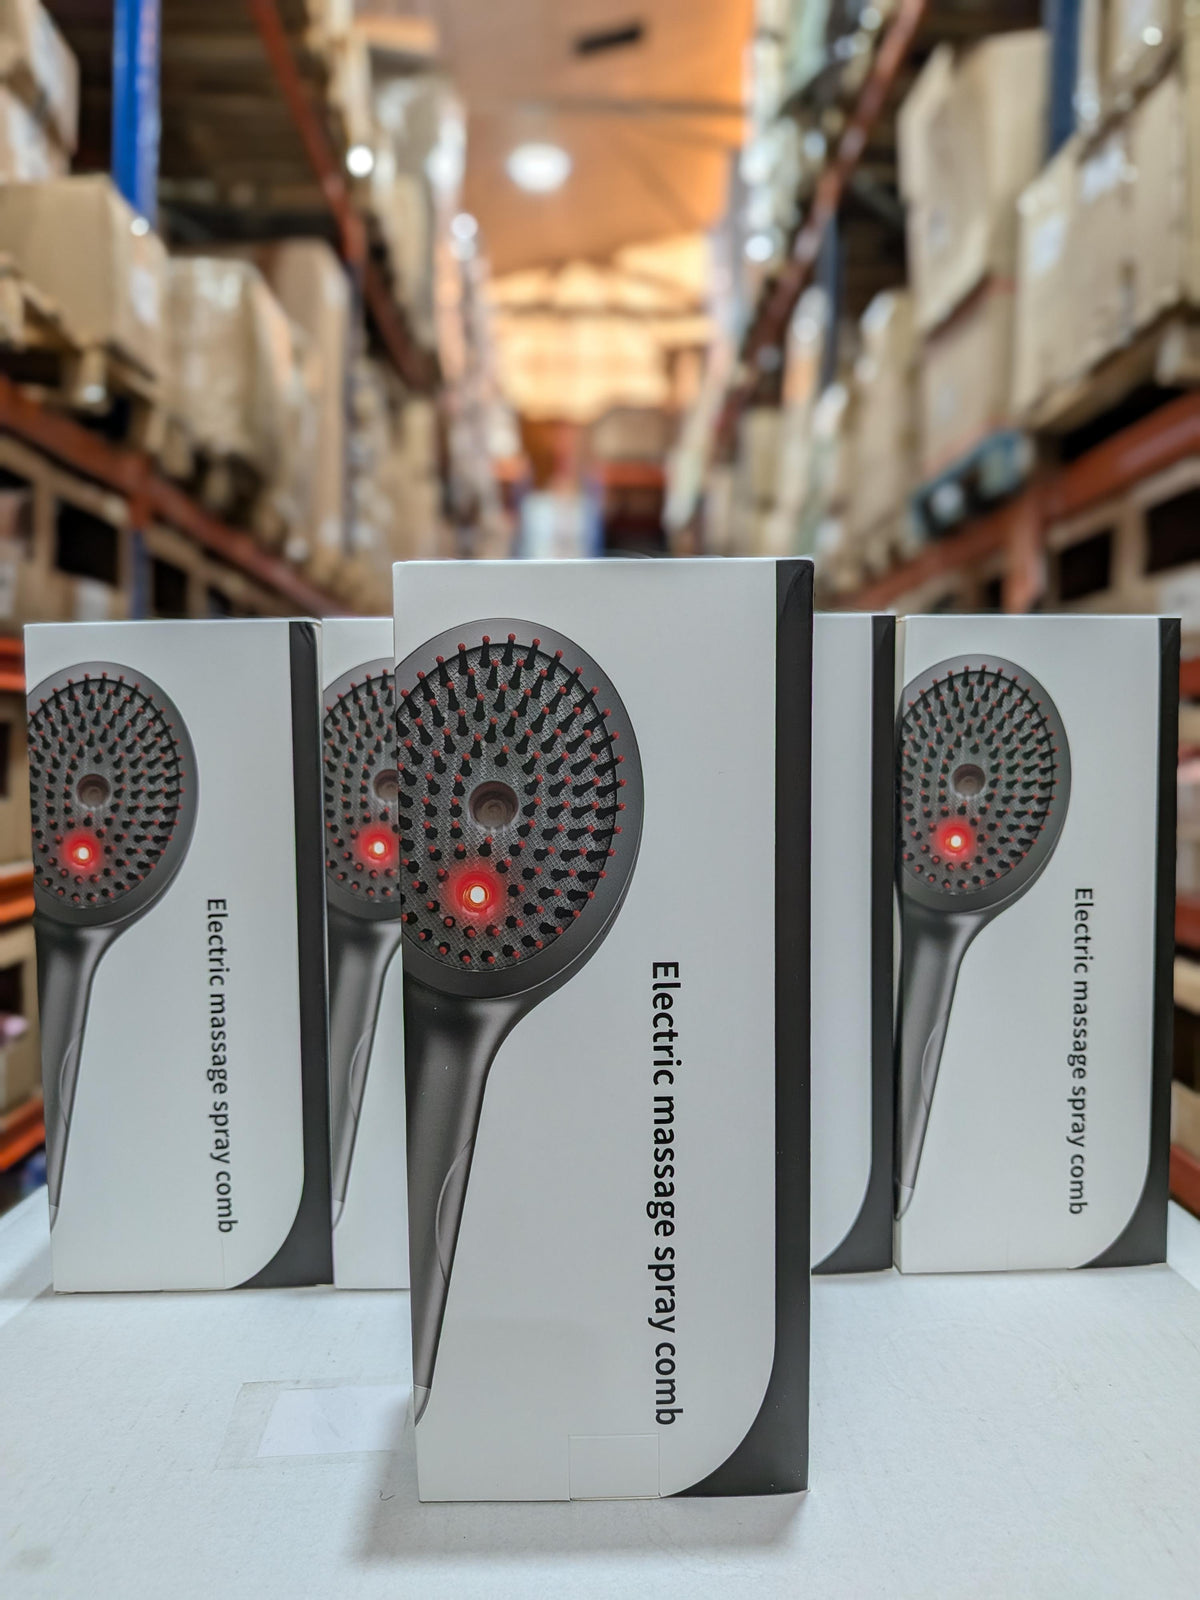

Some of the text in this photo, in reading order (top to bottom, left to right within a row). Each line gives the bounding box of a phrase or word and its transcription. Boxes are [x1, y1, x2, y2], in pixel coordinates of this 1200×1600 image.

[206, 898, 239, 1233] Electric massage spray comb
[645, 961, 684, 1426] Electric massage spray comb
[1065, 887, 1095, 1215] Electric massage spray comb
